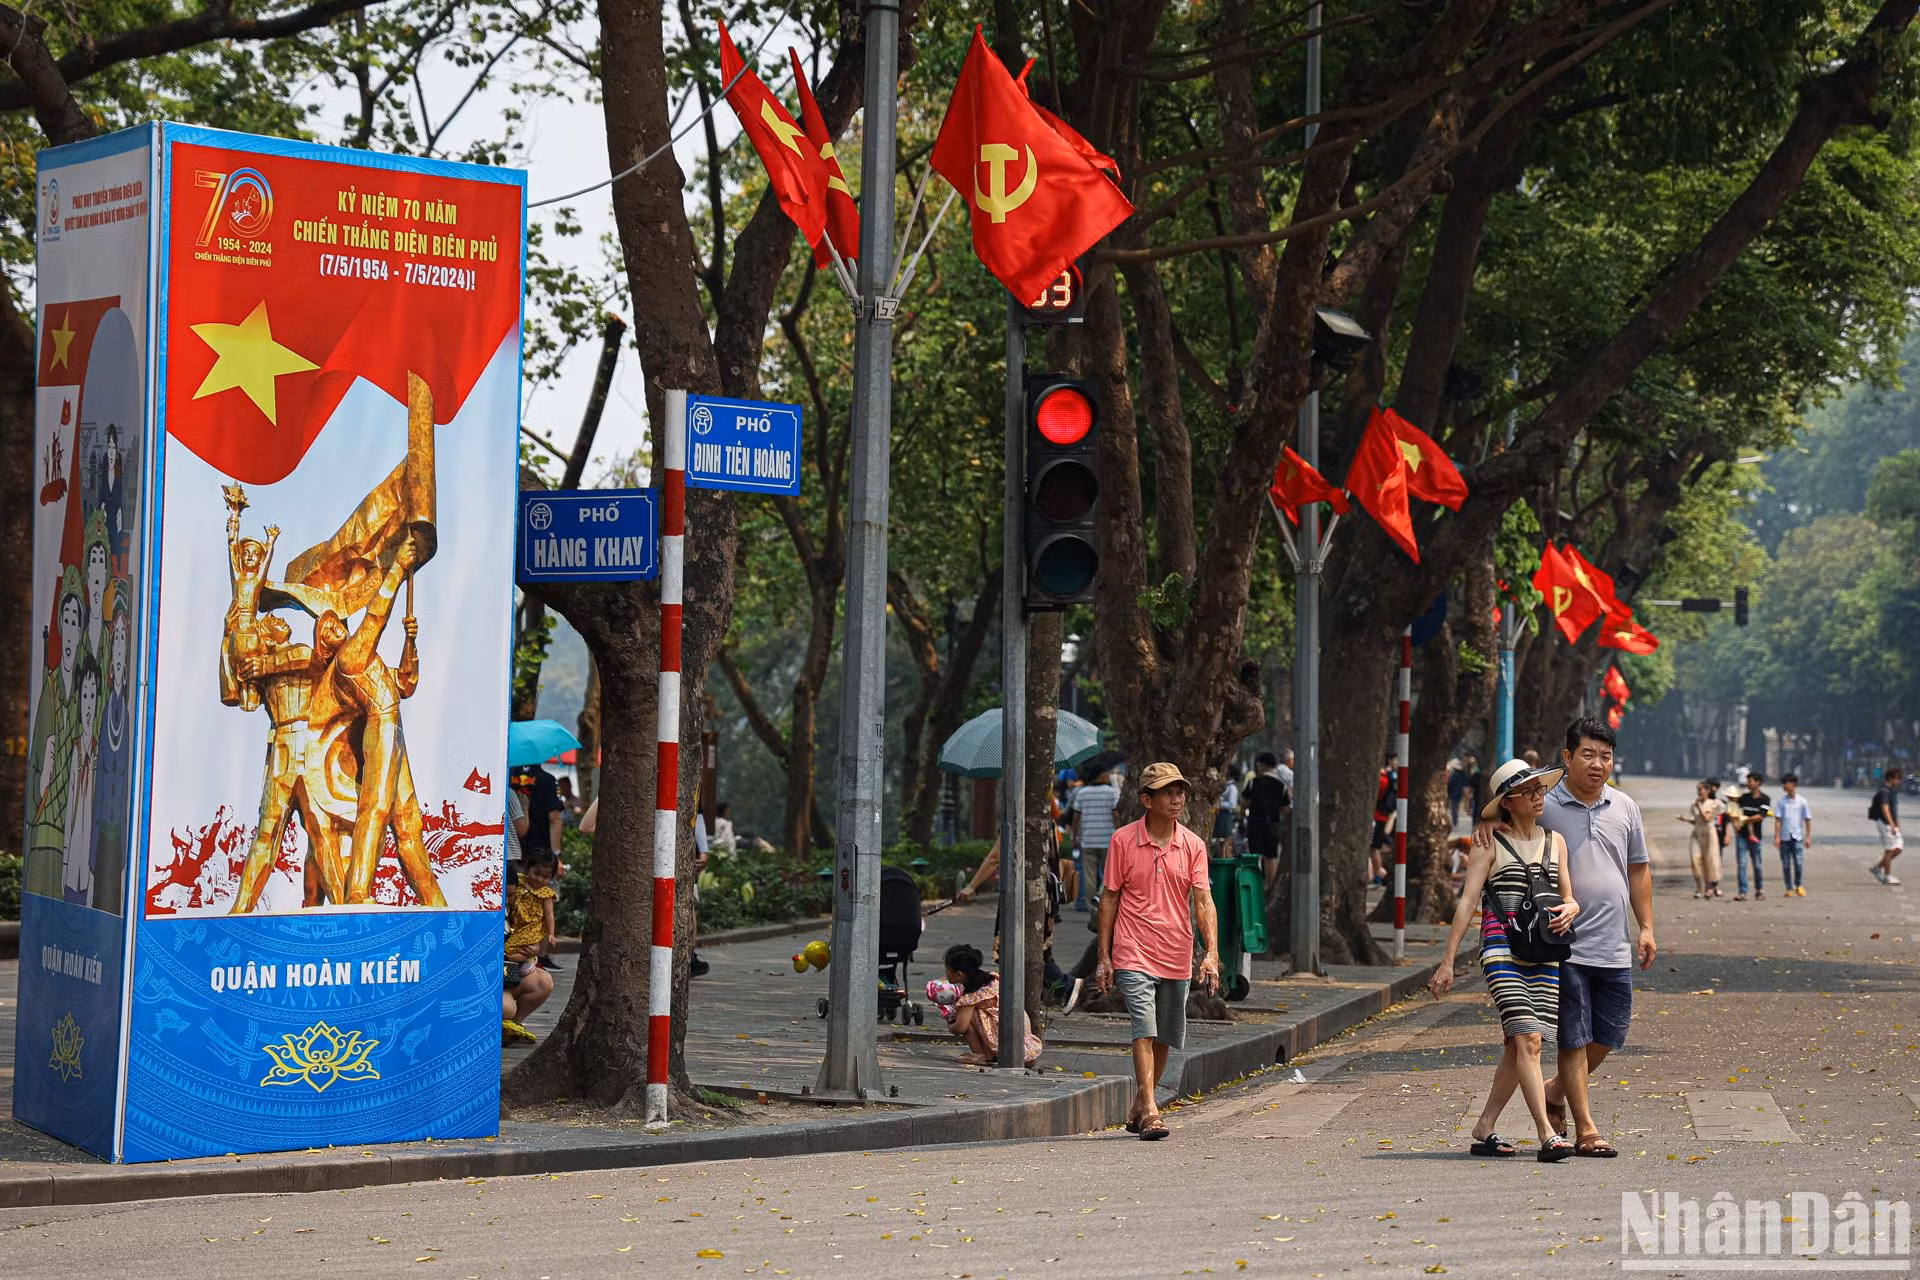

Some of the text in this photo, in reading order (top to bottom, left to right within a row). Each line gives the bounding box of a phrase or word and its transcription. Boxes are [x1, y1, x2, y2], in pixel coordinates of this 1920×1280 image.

[338, 186, 457, 224] KỶ NIỆM 70 NĂM
[218, 236, 240, 251] 1954
[249, 240, 272, 254] 2024
[294, 216, 497, 262] CHIẾN THẮNG ĐIỆN BIÊN PHỦ
[194, 251, 211, 261] CHIẾN
[212, 253, 231, 263] THẮNG
[246, 257, 258, 266] BIÊN
[320, 254, 388, 280] (7/5/1954
[404, 262, 476, 290] 7/5/2024)!
[736, 412, 773, 432] PHỐ
[694, 440, 790, 480] ĐINH TIÊN HOÀNG
[579, 500, 620, 522] PHỐ
[534, 532, 643, 568] HÀNG KHAY
[210, 954, 420, 994] QUẬN HOÀN KIẾM
